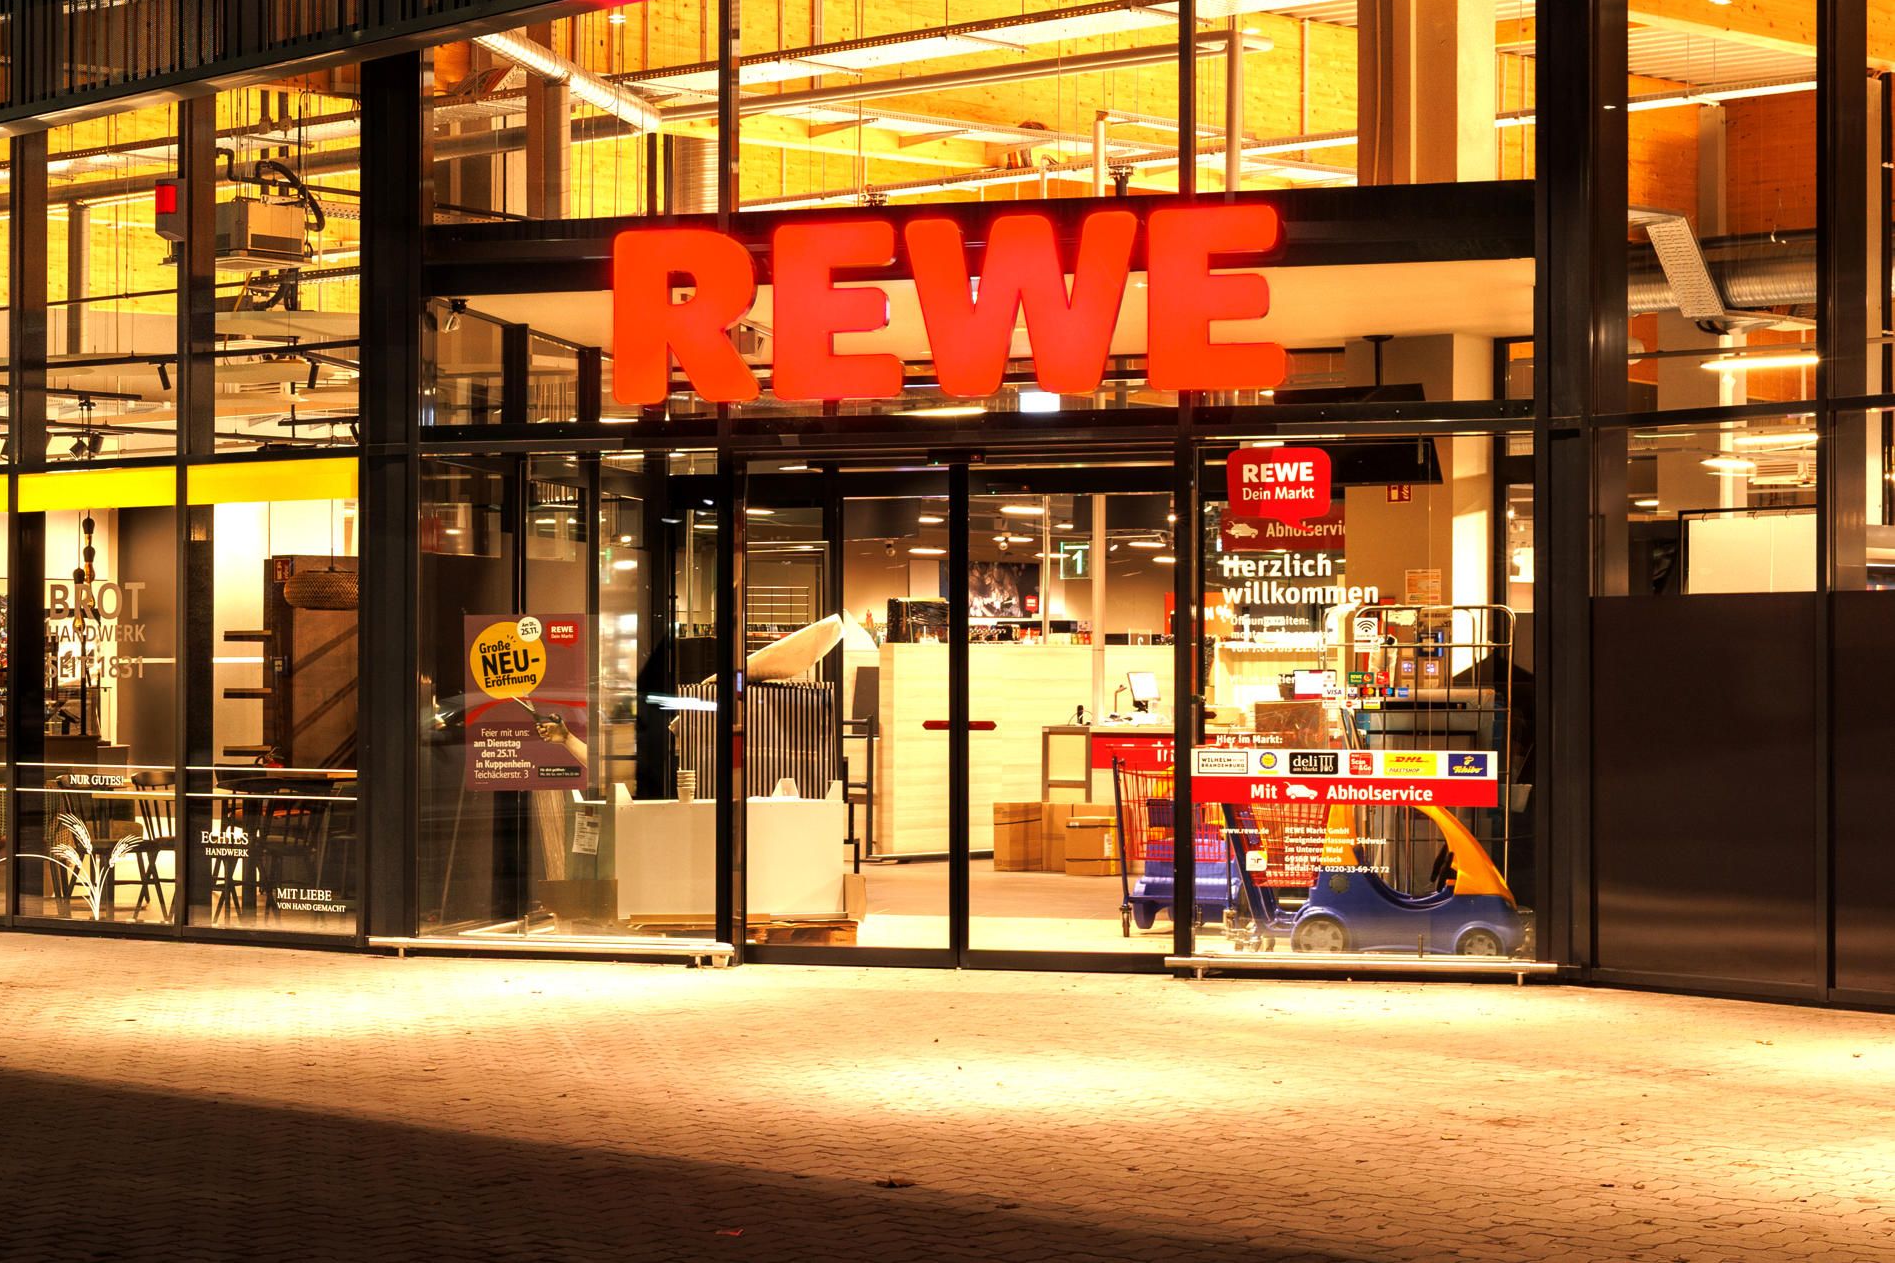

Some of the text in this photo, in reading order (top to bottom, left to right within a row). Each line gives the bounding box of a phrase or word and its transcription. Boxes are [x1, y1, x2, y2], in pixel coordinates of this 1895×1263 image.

[613, 203, 1286, 405] REWE
[1242, 462, 1315, 483] REWE
[1242, 486, 1315, 501] Dein Markt
[1072, 549, 1083, 575] 1
[1222, 553, 1332, 577] Herzlich
[1221, 581, 1379, 604] willkommen
[50, 582, 146, 620] BROT
[48, 624, 146, 643] HANDWERK
[520, 626, 539, 636] 25.11.
[551, 625, 574, 633] REWE
[479, 640, 511, 654] Große
[45, 655, 144, 679] SEIT 1831
[481, 648, 540, 677] NEU-
[484, 674, 537, 688] Eröffnung
[481, 728, 530, 737] Feier mit uns:
[1216, 735, 1283, 744] Hier im Markt:
[487, 739, 521, 749] Dienstag
[481, 749, 518, 758] den 25.11.
[476, 760, 484, 768] in
[1293, 755, 1318, 767] deli
[70, 774, 124, 786] NUR GUTES!
[474, 770, 523, 779] Teichäckerstr.
[524, 769, 529, 779] 3
[1251, 784, 1433, 801] Mit Abholservice
[201, 830, 249, 846] ECHTES
[1220, 827, 1269, 835] www.rewe.de
[1284, 837, 1387, 845] Zweigniederlassung Südwest
[205, 848, 249, 857] HANDWERK
[277, 888, 332, 902] MIT LIEBE
[277, 902, 346, 913] VON HAND GEMACHT
